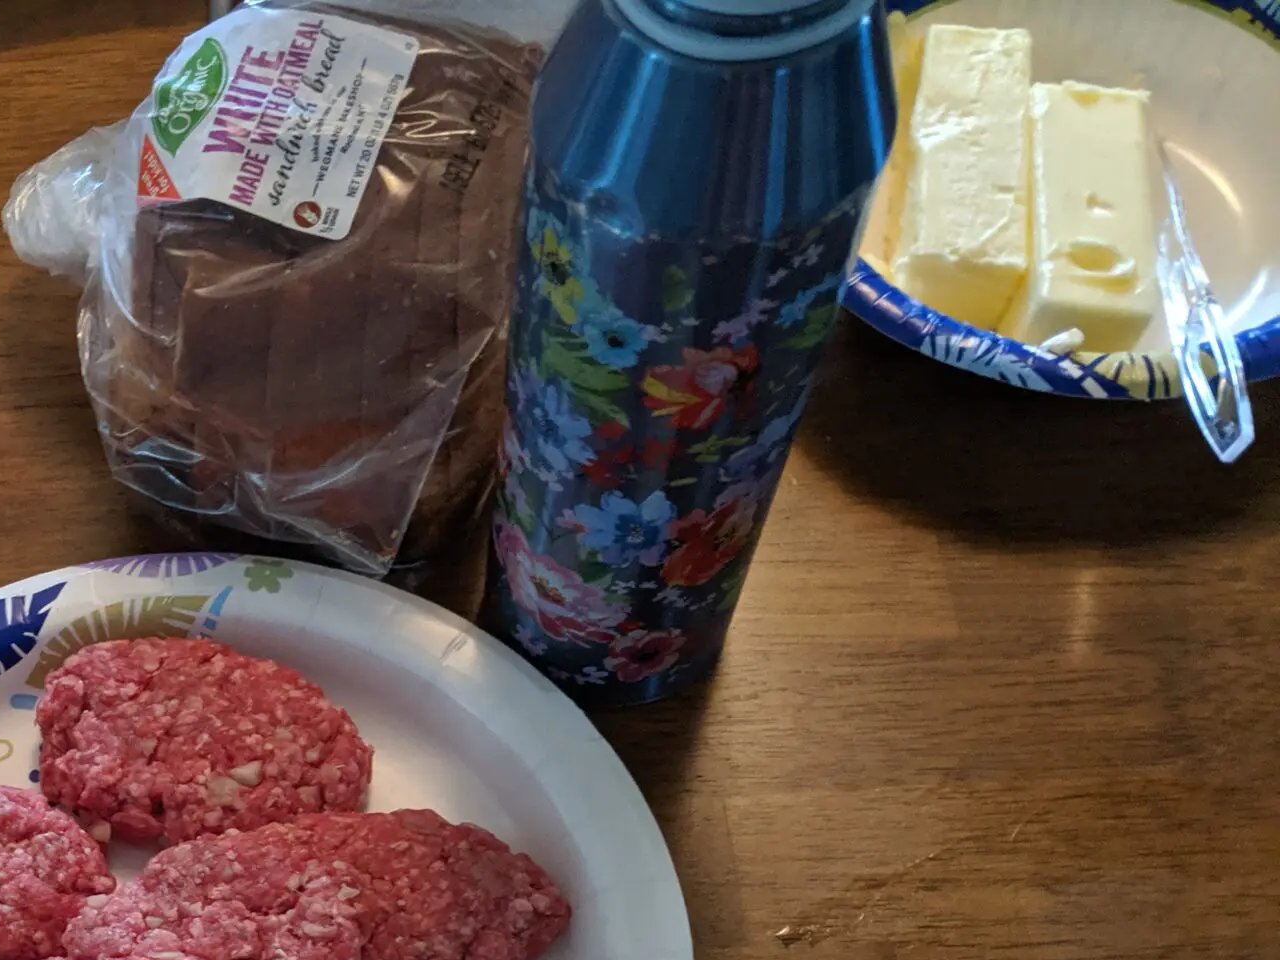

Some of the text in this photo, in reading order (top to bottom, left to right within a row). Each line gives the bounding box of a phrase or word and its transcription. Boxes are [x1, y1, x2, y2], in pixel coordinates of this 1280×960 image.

[201, 45, 287, 154] WHITE
[228, 19, 324, 206] MADE WITH OATMEAL
[268, 97, 318, 207] sandwich
[301, 28, 346, 94] bread
[346, 179, 360, 198] NET
[353, 163, 366, 178] WT
[360, 149, 372, 161] 20
